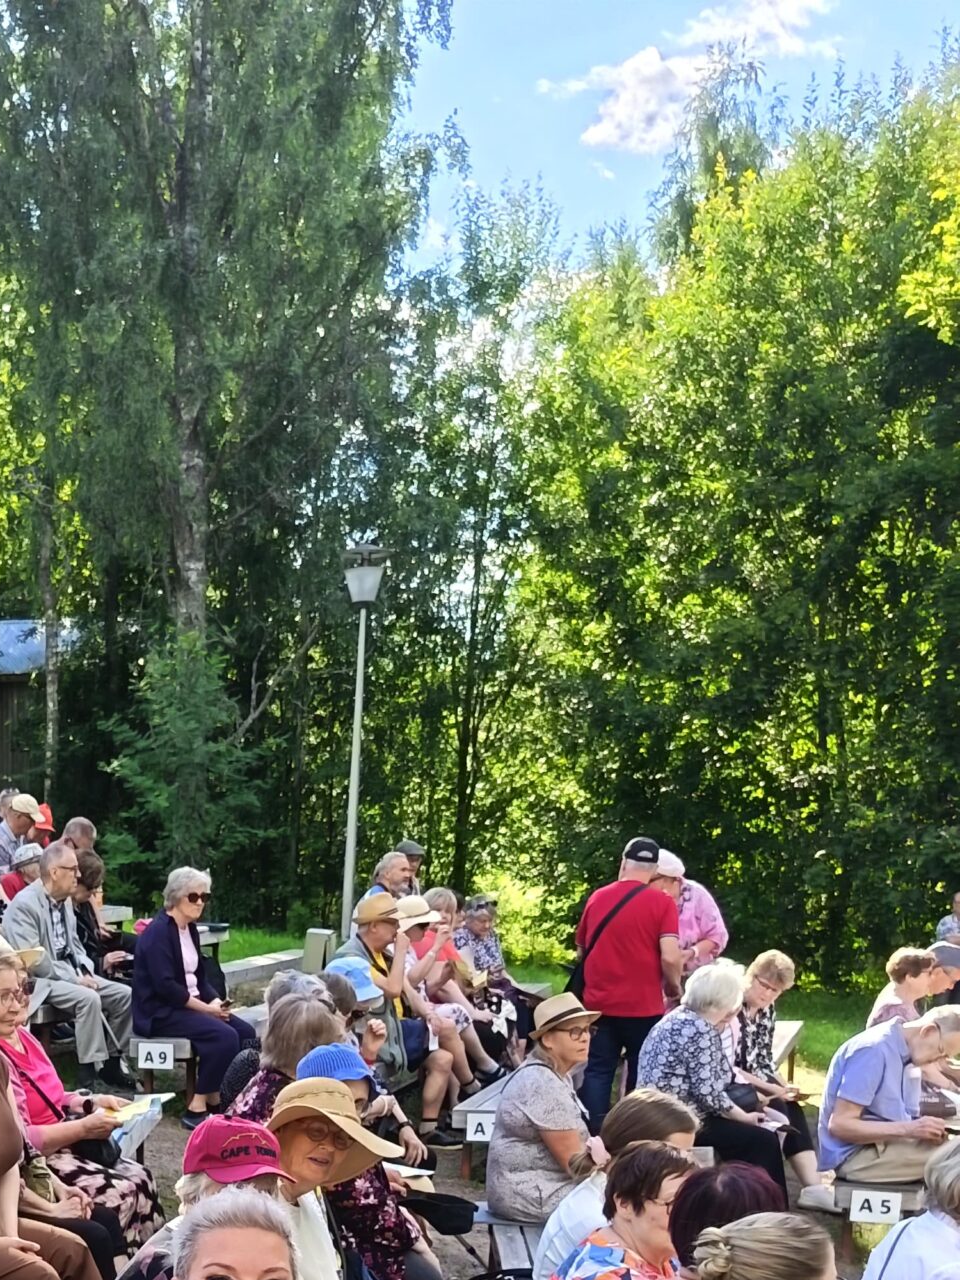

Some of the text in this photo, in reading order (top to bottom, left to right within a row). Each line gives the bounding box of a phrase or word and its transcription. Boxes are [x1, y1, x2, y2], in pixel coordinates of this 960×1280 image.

[144, 1051, 167, 1065] A 9
[473, 1122, 486, 1136] A
[221, 1146, 250, 1160] CAPE
[859, 1198, 891, 1214] A 5
